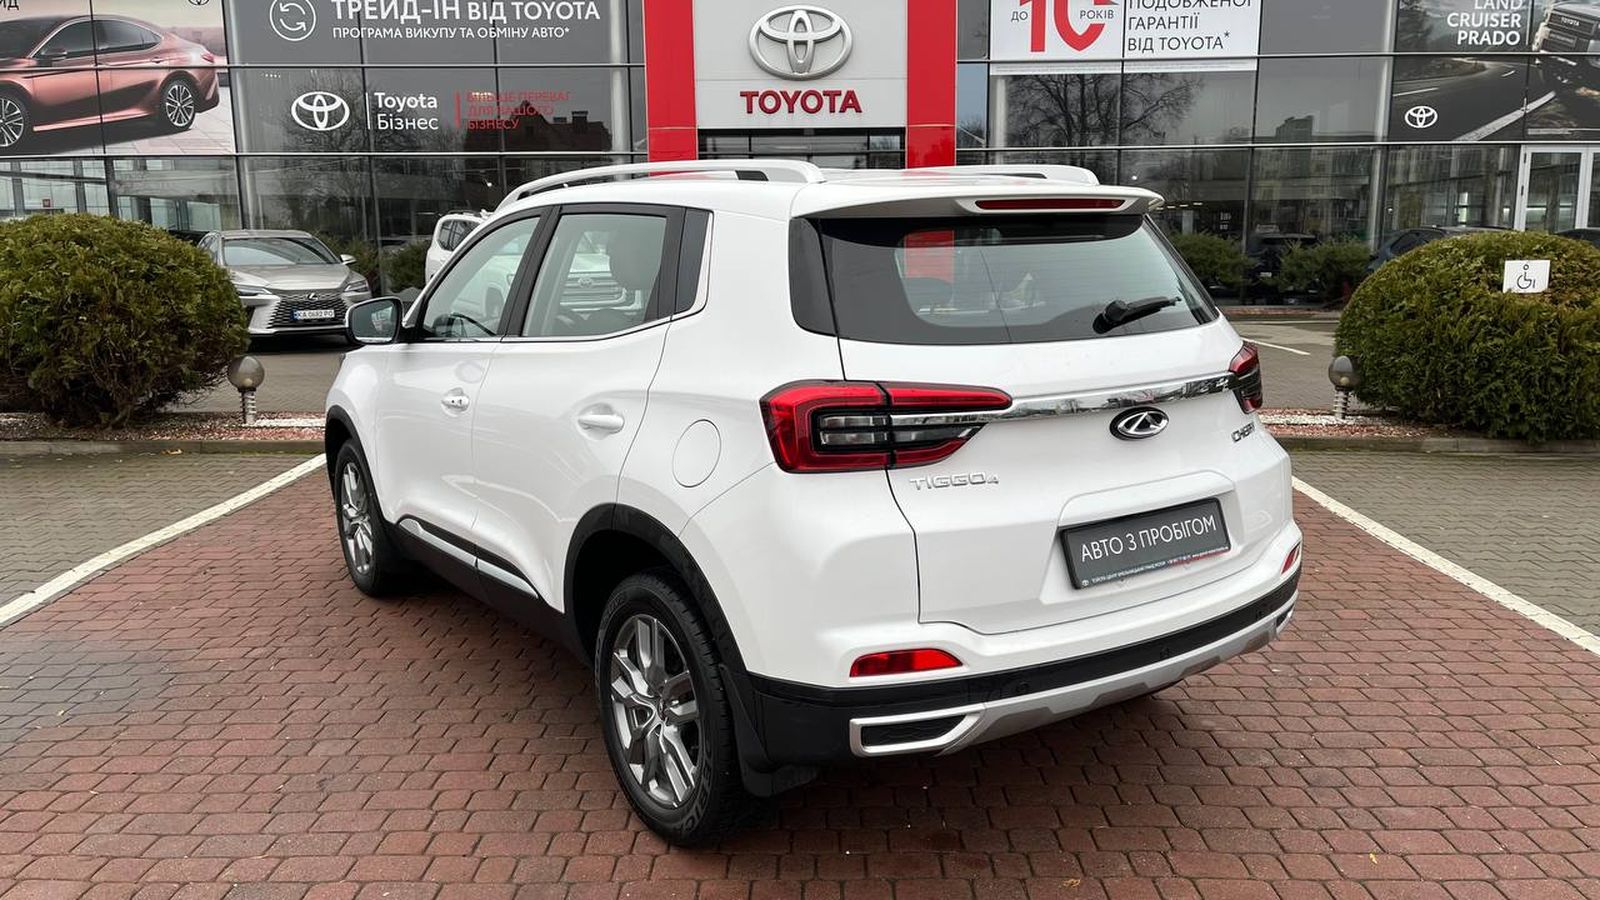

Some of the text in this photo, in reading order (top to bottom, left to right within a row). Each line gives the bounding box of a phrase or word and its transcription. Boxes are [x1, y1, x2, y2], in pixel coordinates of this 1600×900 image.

[467, 1, 507, 24] ВІД
[511, 1, 600, 20] TOYOTA
[1474, 0, 1523, 10] LAND
[1011, 11, 1029, 22] ДО
[1079, 9, 1115, 20] РОКІВ
[1128, 12, 1200, 30] ГАРАНТІЇ
[1447, 12, 1522, 28] CRUISER
[333, 27, 402, 39] ПРОГРАМА
[405, 27, 456, 39] ВИКУПУ
[459, 27, 475, 38] ТА
[477, 26, 528, 39] ОБМІНУ
[1457, 30, 1521, 46] PRADO
[1128, 37, 1154, 54] ВІД
[374, 92, 438, 113] Toyota
[740, 90, 863, 115] TOYOTA
[377, 113, 439, 130] Бізнес
[468, 119, 520, 130] БІЗНЕСУ
[909, 472, 987, 491] TIGGO
[1081, 536, 1124, 562] АВТО
[1139, 515, 1217, 548] ПРОБІГОМ
